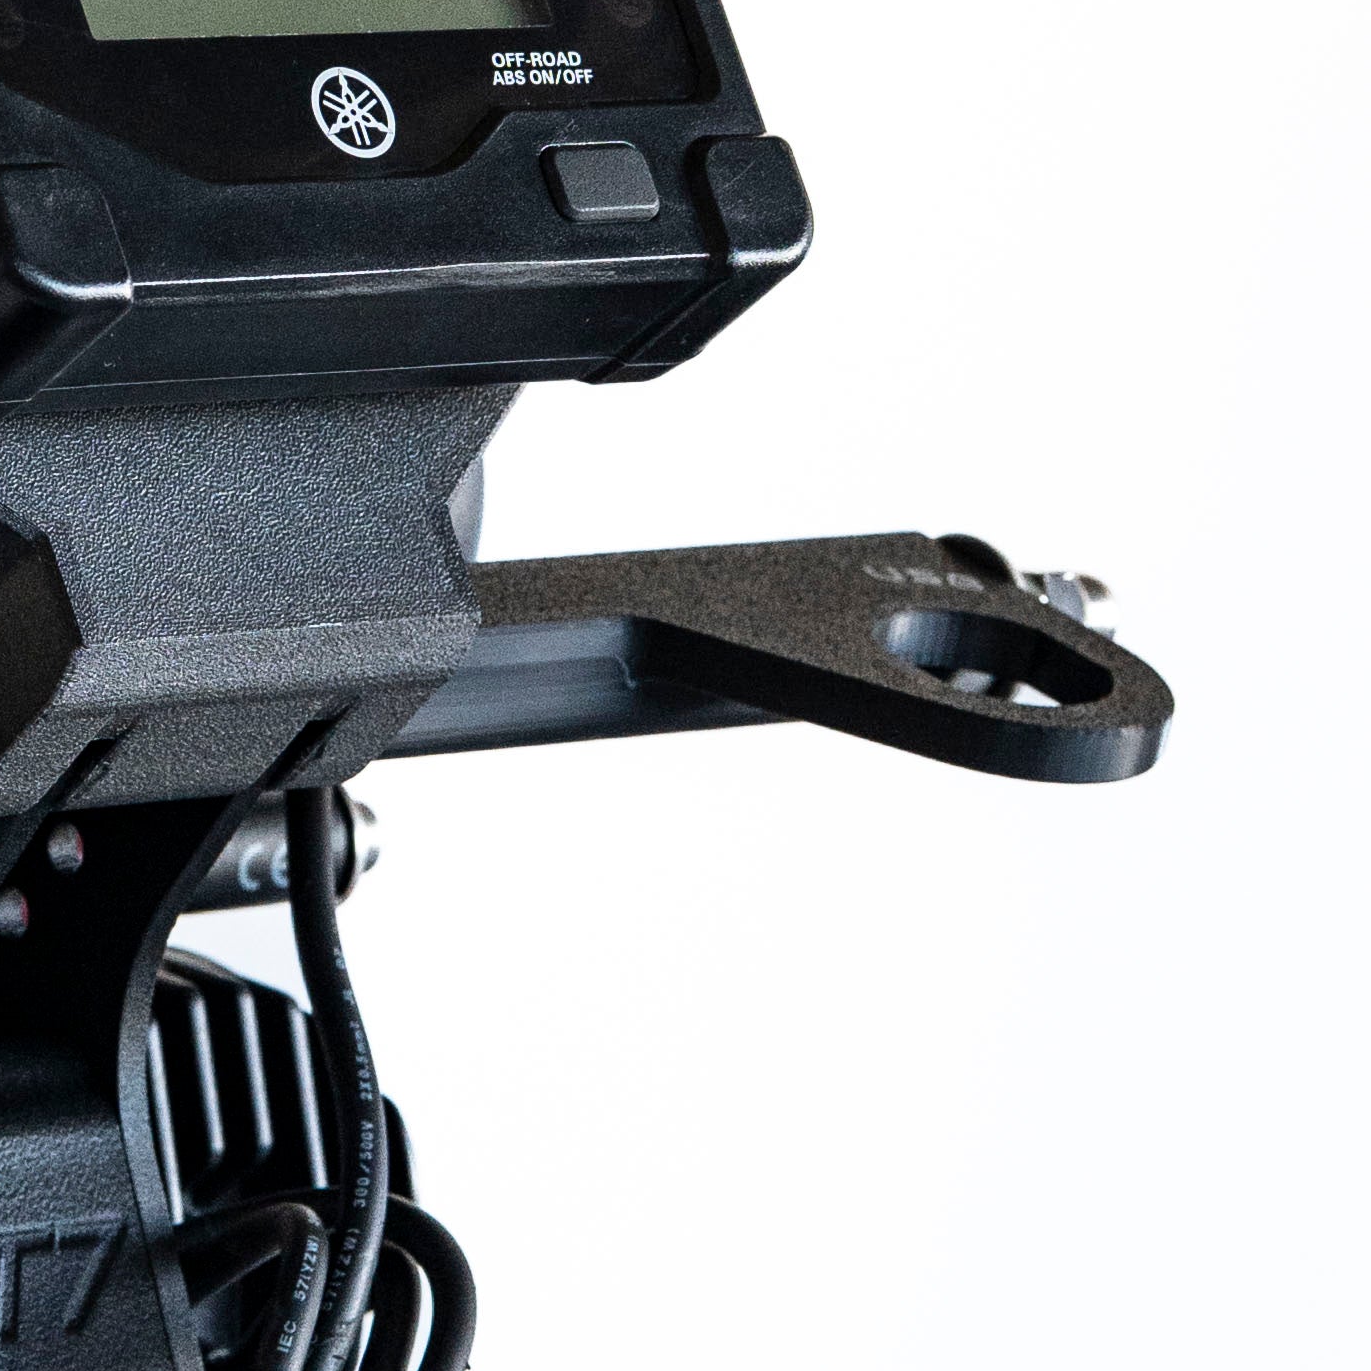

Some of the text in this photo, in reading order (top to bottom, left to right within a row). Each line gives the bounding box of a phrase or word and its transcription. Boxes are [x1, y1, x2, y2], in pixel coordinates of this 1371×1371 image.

[491, 51, 582, 68] OFF-ROAD
[492, 69, 594, 86] ABS ON/OFF
[353, 1120, 375, 1209] 300/500V
[277, 1319, 297, 1355] IEC
